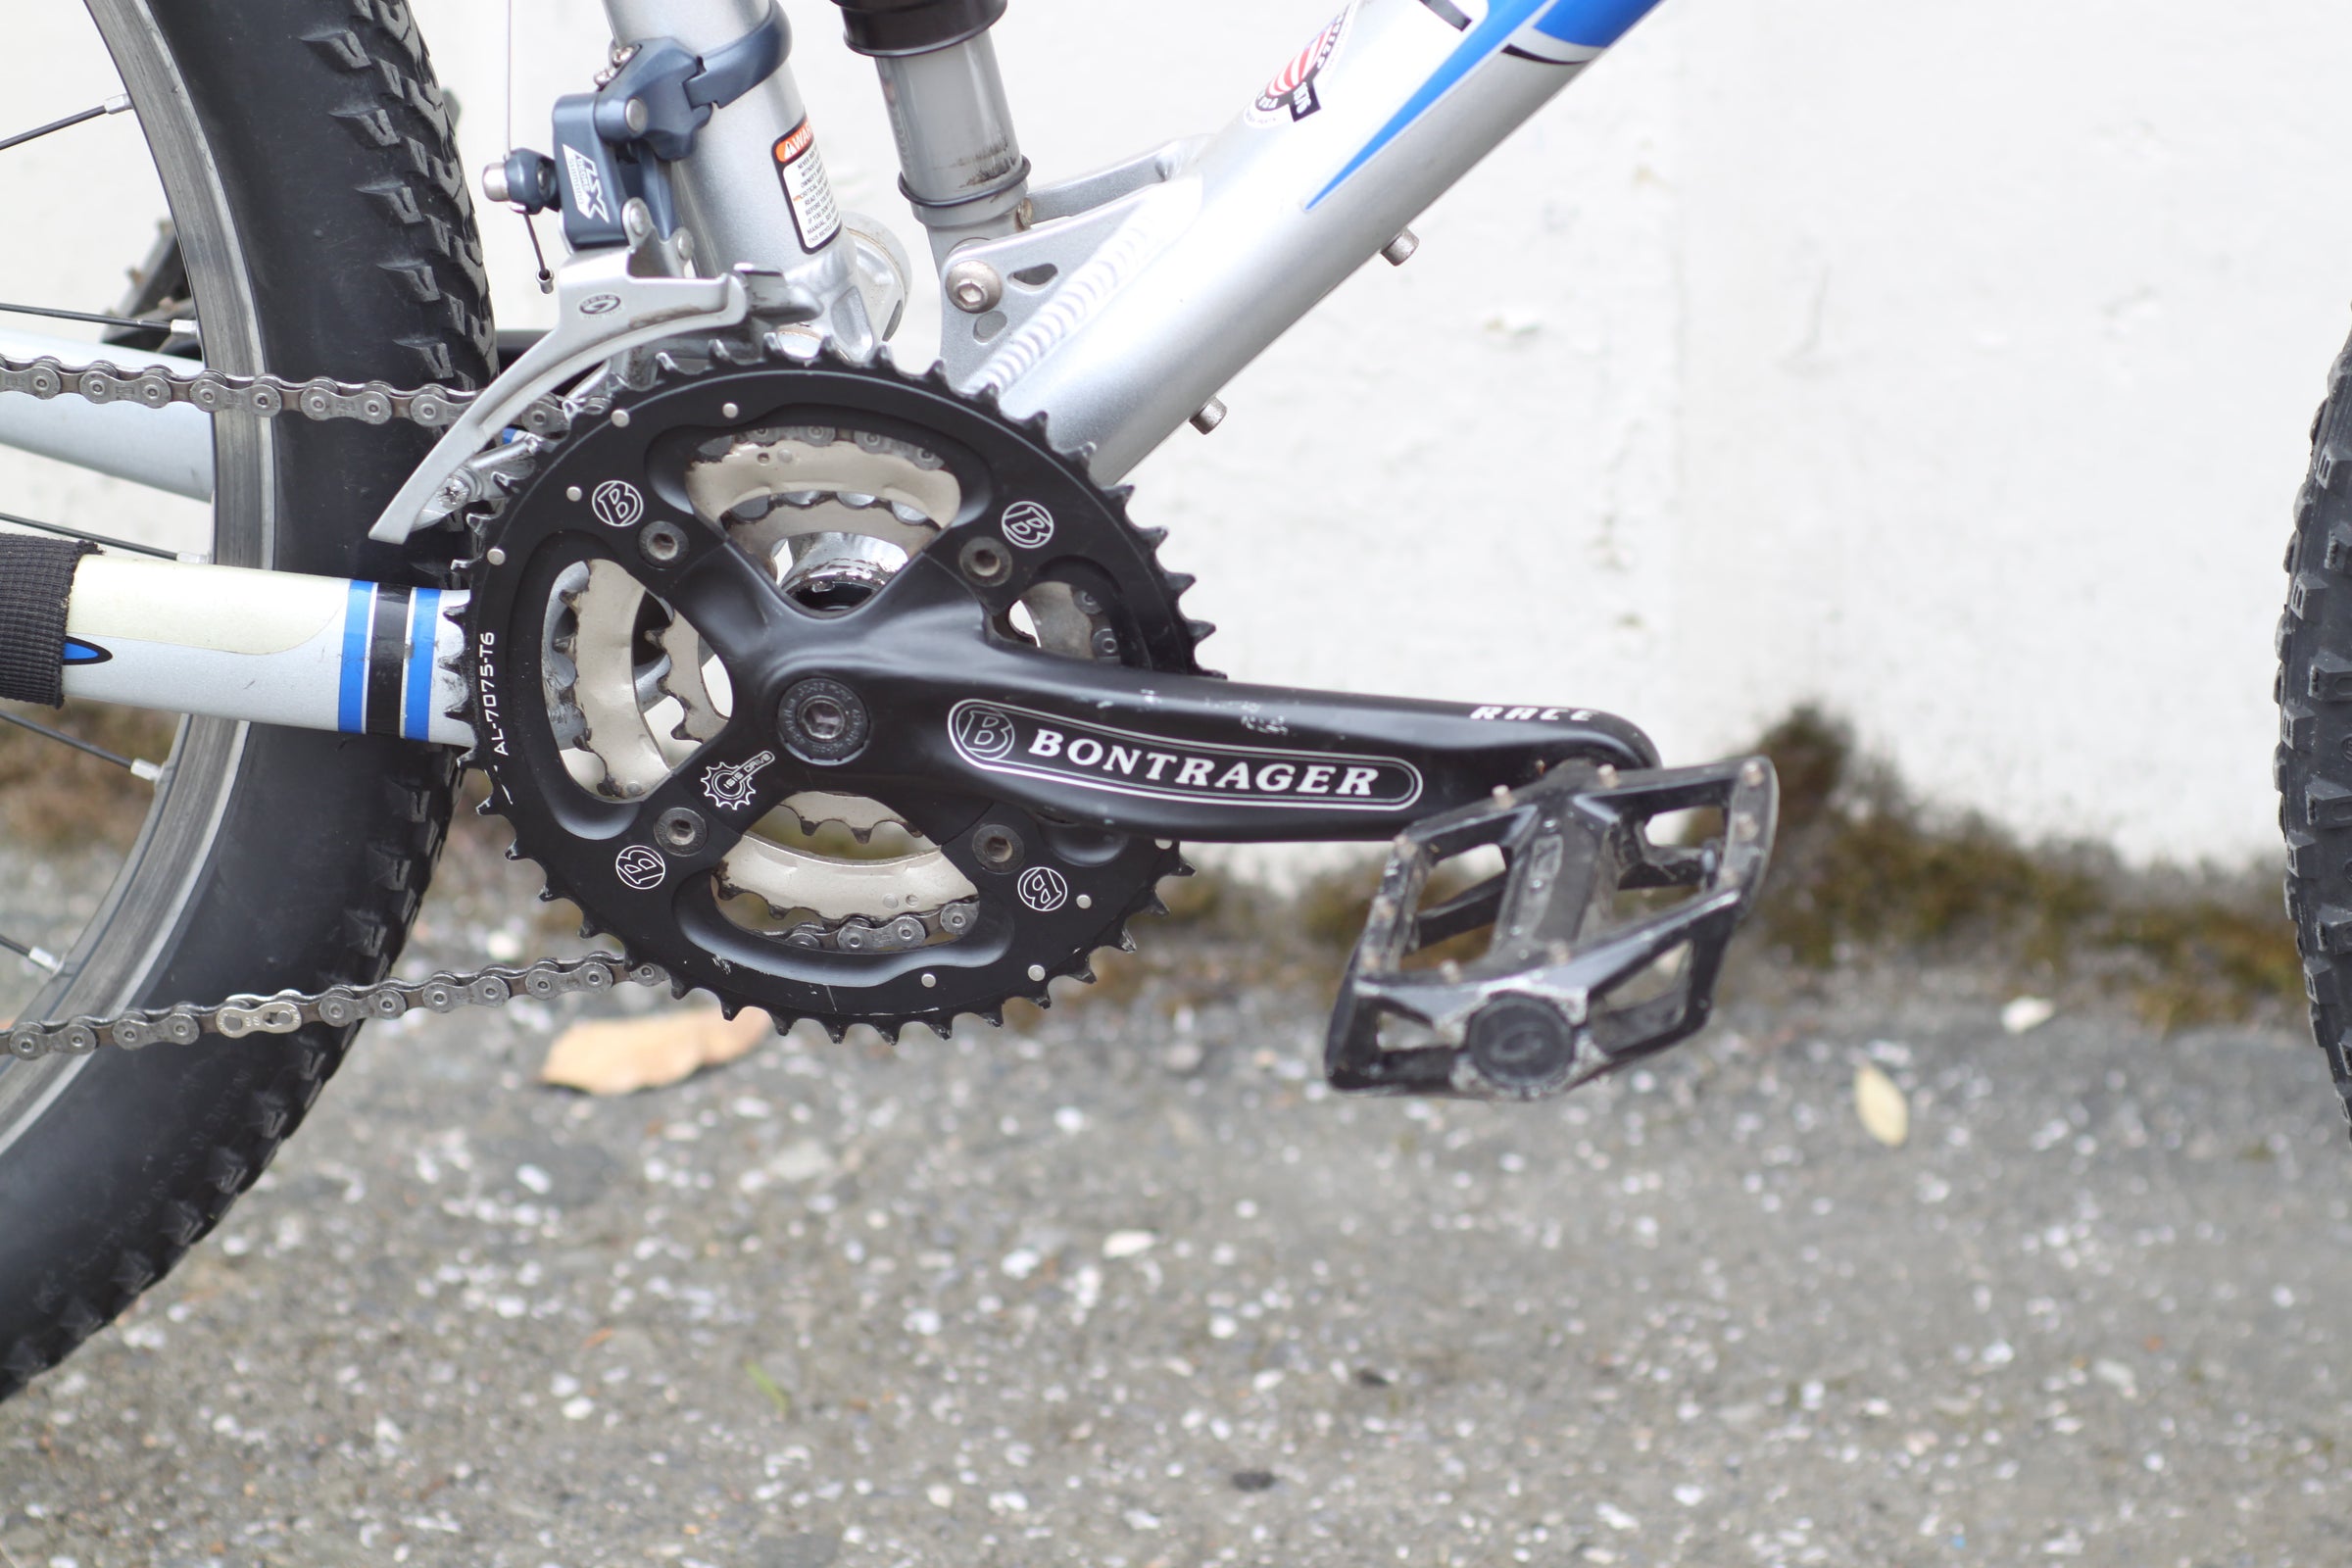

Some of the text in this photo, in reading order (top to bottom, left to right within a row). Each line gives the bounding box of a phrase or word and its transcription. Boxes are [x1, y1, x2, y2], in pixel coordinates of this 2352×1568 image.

[478, 632, 510, 757] AL-7075-T6
[1469, 706, 1600, 722] RACE
[723, 754, 771, 790] ISIS DRIVE
[1028, 728, 1380, 797] BONTRAGER
